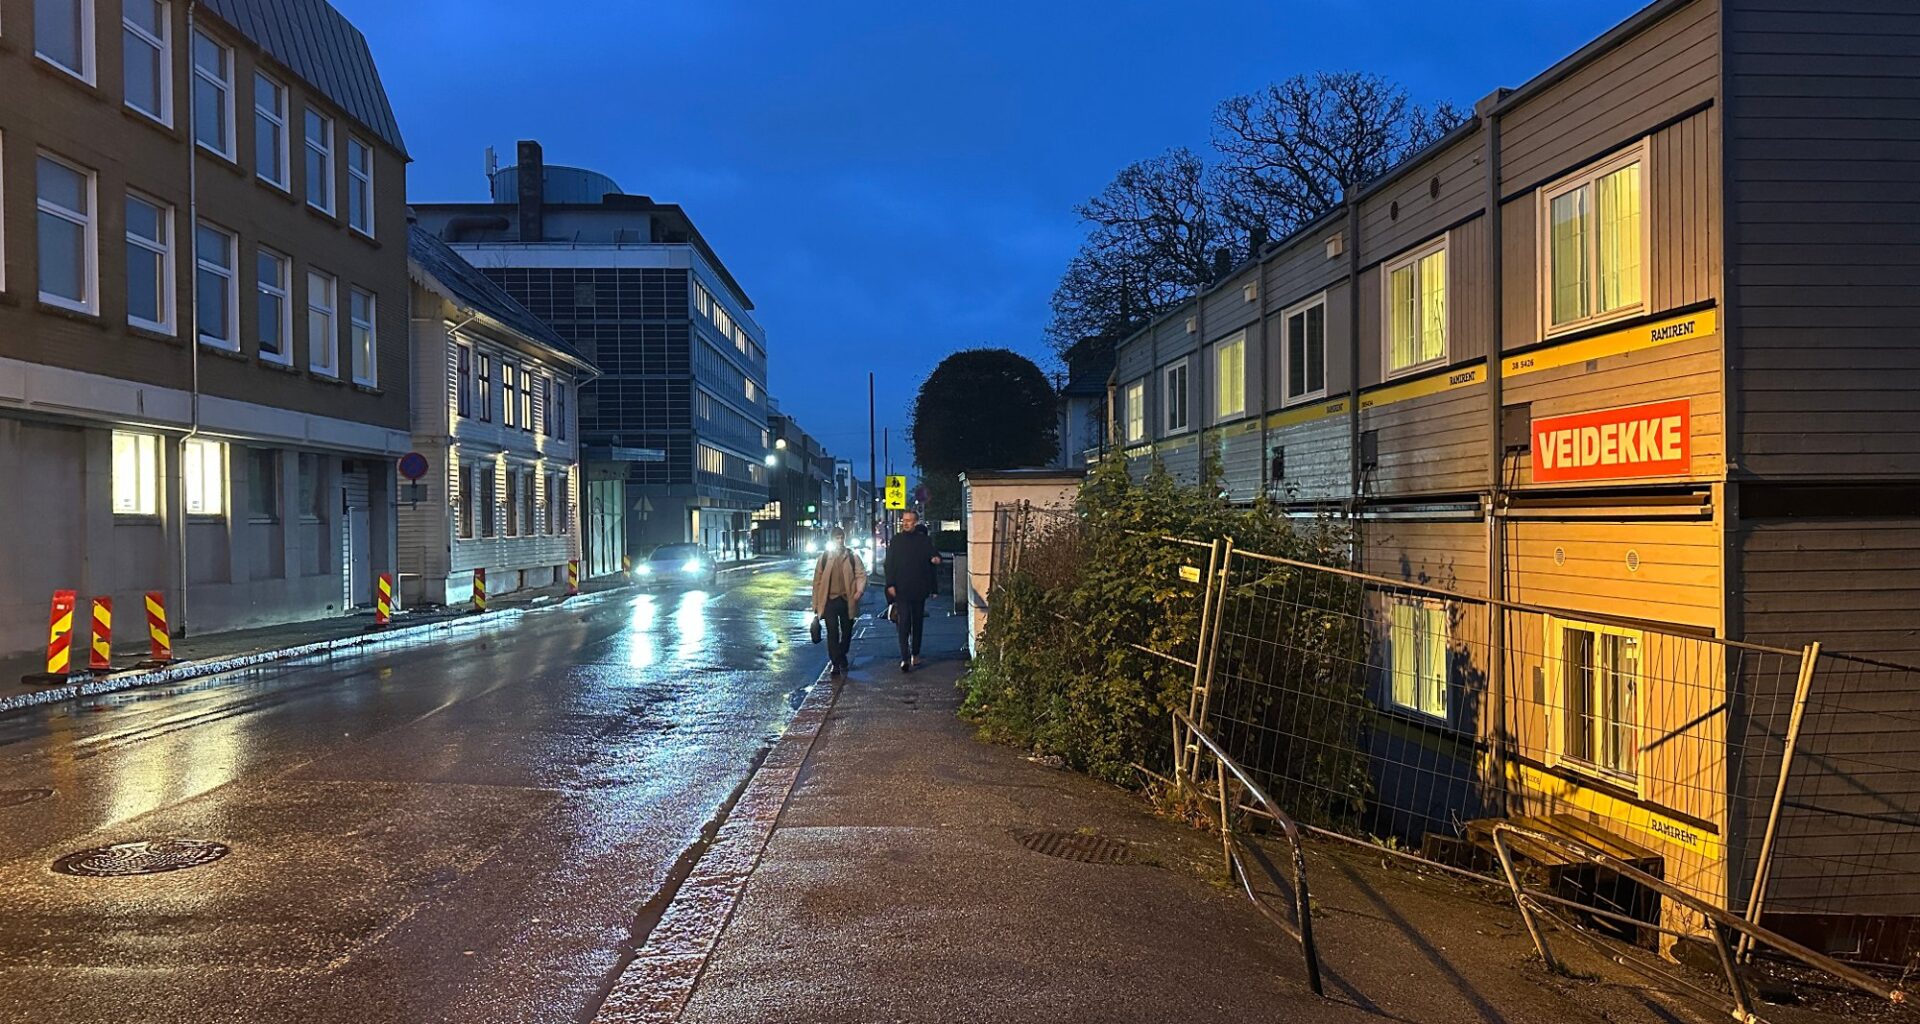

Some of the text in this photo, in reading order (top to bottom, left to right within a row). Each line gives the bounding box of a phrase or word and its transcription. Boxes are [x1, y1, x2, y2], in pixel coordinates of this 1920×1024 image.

[1651, 320, 1695, 342] RAMIRENT
[1538, 415, 1682, 469] VEIDEKKE
[1651, 818, 1698, 847] RAMIRENT
